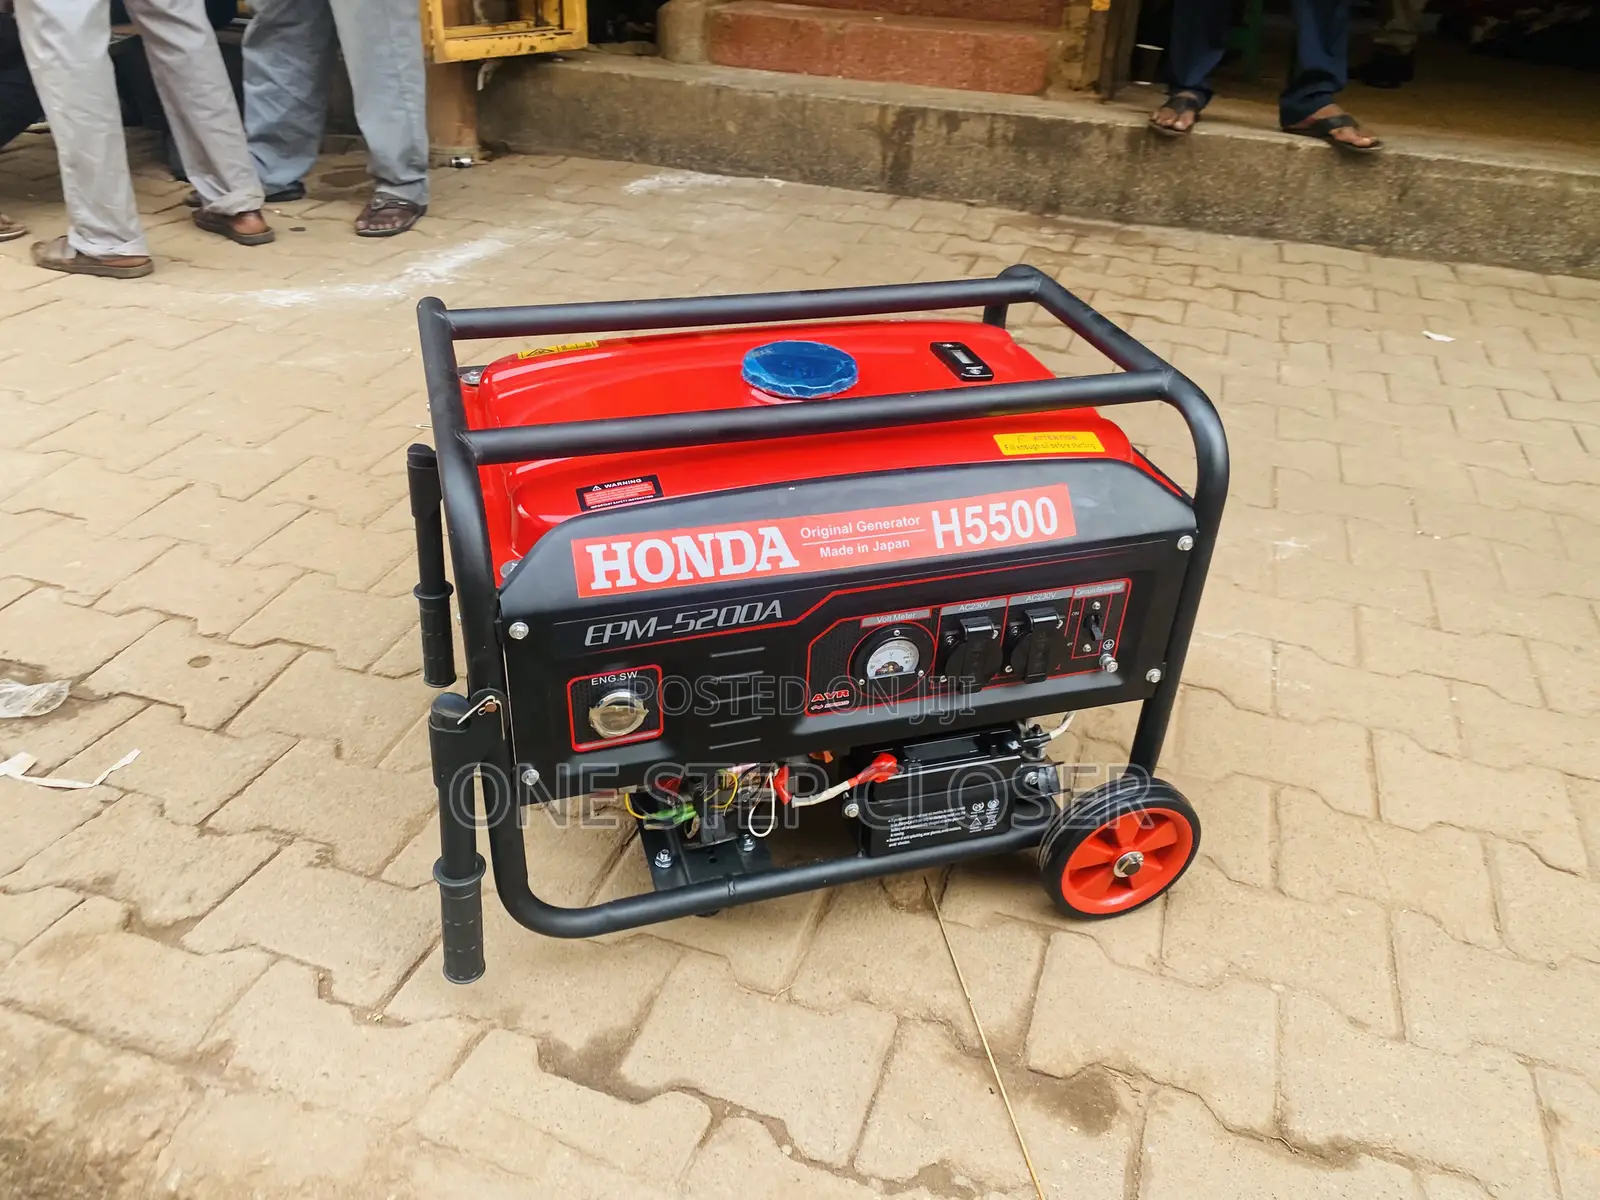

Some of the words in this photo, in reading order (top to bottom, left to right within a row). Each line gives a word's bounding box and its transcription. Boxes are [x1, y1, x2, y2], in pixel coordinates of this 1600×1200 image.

[604, 478, 642, 489] WARNING
[800, 521, 853, 540] Original
[857, 515, 920, 533] Generator
[932, 496, 1058, 549] H5500
[820, 546, 854, 559] Made
[857, 543, 868, 553] in
[873, 538, 910, 554] Japan
[586, 526, 800, 590] HONDA
[1025, 592, 1057, 602] AC230V
[958, 601, 991, 612] AC230V
[584, 600, 783, 647] EPM-5200A
[876, 616, 892, 624] Volt
[893, 612, 916, 621] Meter
[591, 670, 638, 686] ENG.SW
[811, 689, 849, 702] AVR
